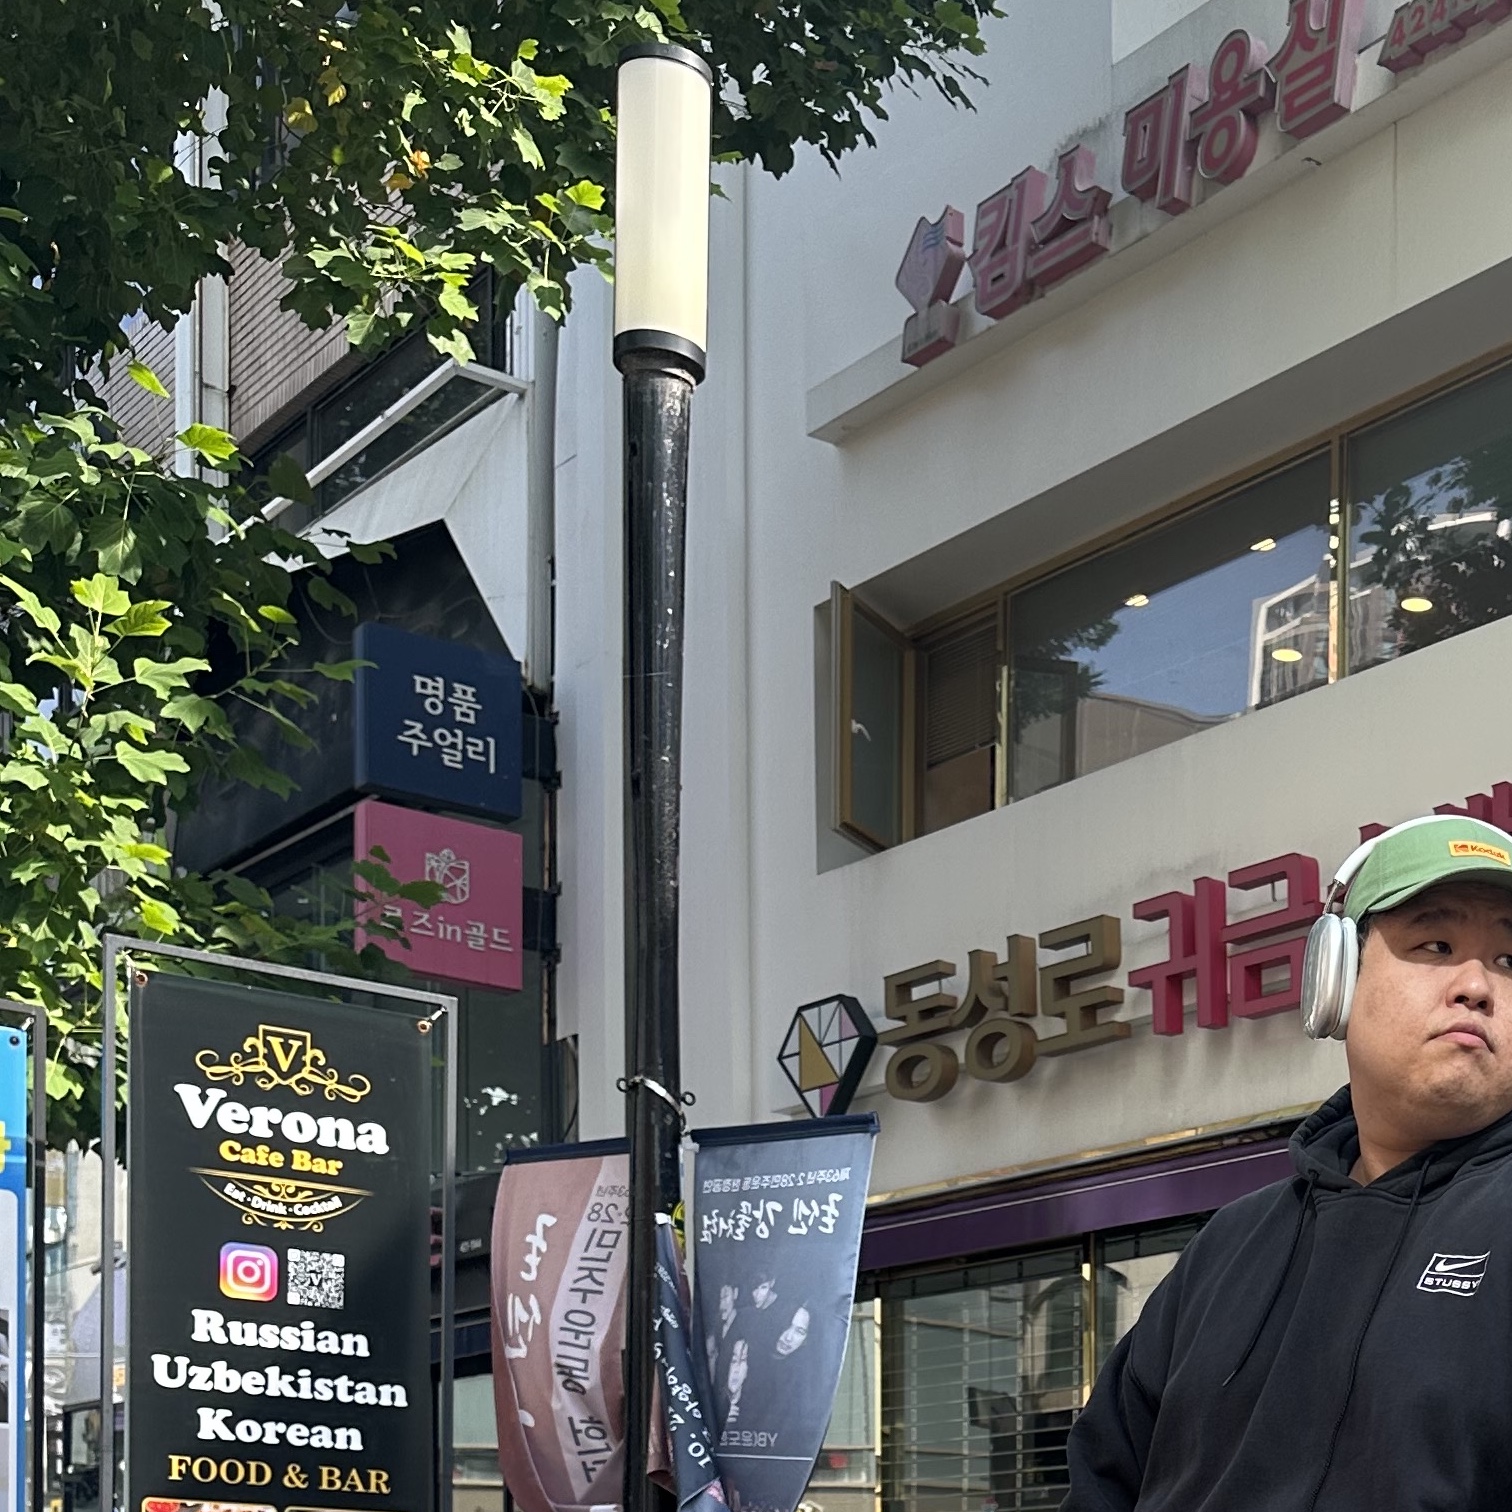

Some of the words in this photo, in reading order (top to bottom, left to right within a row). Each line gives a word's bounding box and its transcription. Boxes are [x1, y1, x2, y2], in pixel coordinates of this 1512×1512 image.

[1121, 0, 1363, 216] 미용실
[412, 672, 483, 725] 명품
[396, 719, 497, 775] 주얼리
[877, 914, 1132, 1103] 동성로
[266, 1039, 302, 1074] V
[173, 1083, 390, 1156] Verona
[219, 1140, 285, 1170] Cafe
[291, 1147, 344, 1178] Bar
[1424, 1276, 1480, 1290] STUSSY
[191, 1309, 371, 1357] Russian
[151, 1354, 408, 1408] Uzbekistan
[197, 1409, 364, 1451] Korean
[168, 1454, 272, 1488] FOOD
[283, 1465, 309, 1490] &
[319, 1466, 391, 1495] BAR
